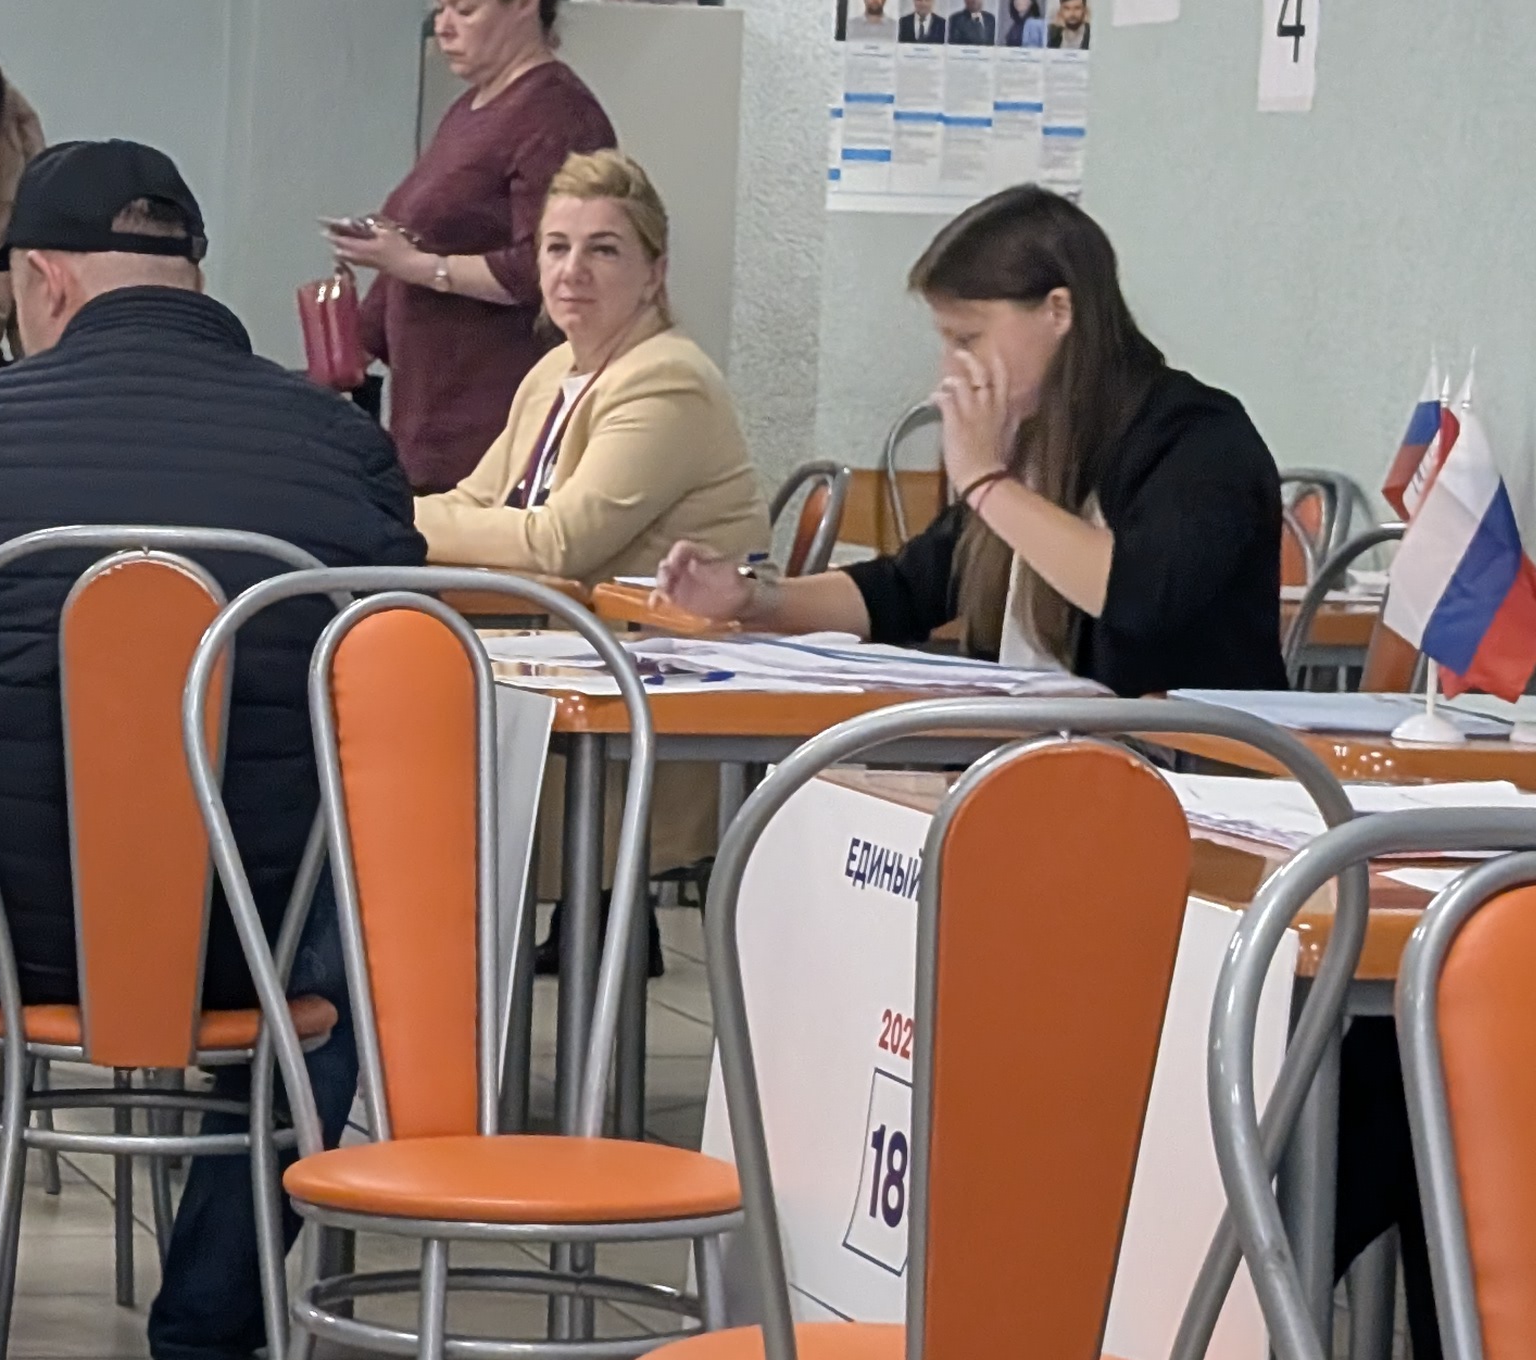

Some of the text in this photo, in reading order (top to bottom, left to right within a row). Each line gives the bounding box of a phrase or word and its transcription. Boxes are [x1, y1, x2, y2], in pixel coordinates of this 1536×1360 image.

[844, 836, 925, 902] ЕДИНЫЙ
[878, 1008, 914, 1060] 202
[869, 1123, 908, 1228] 18
